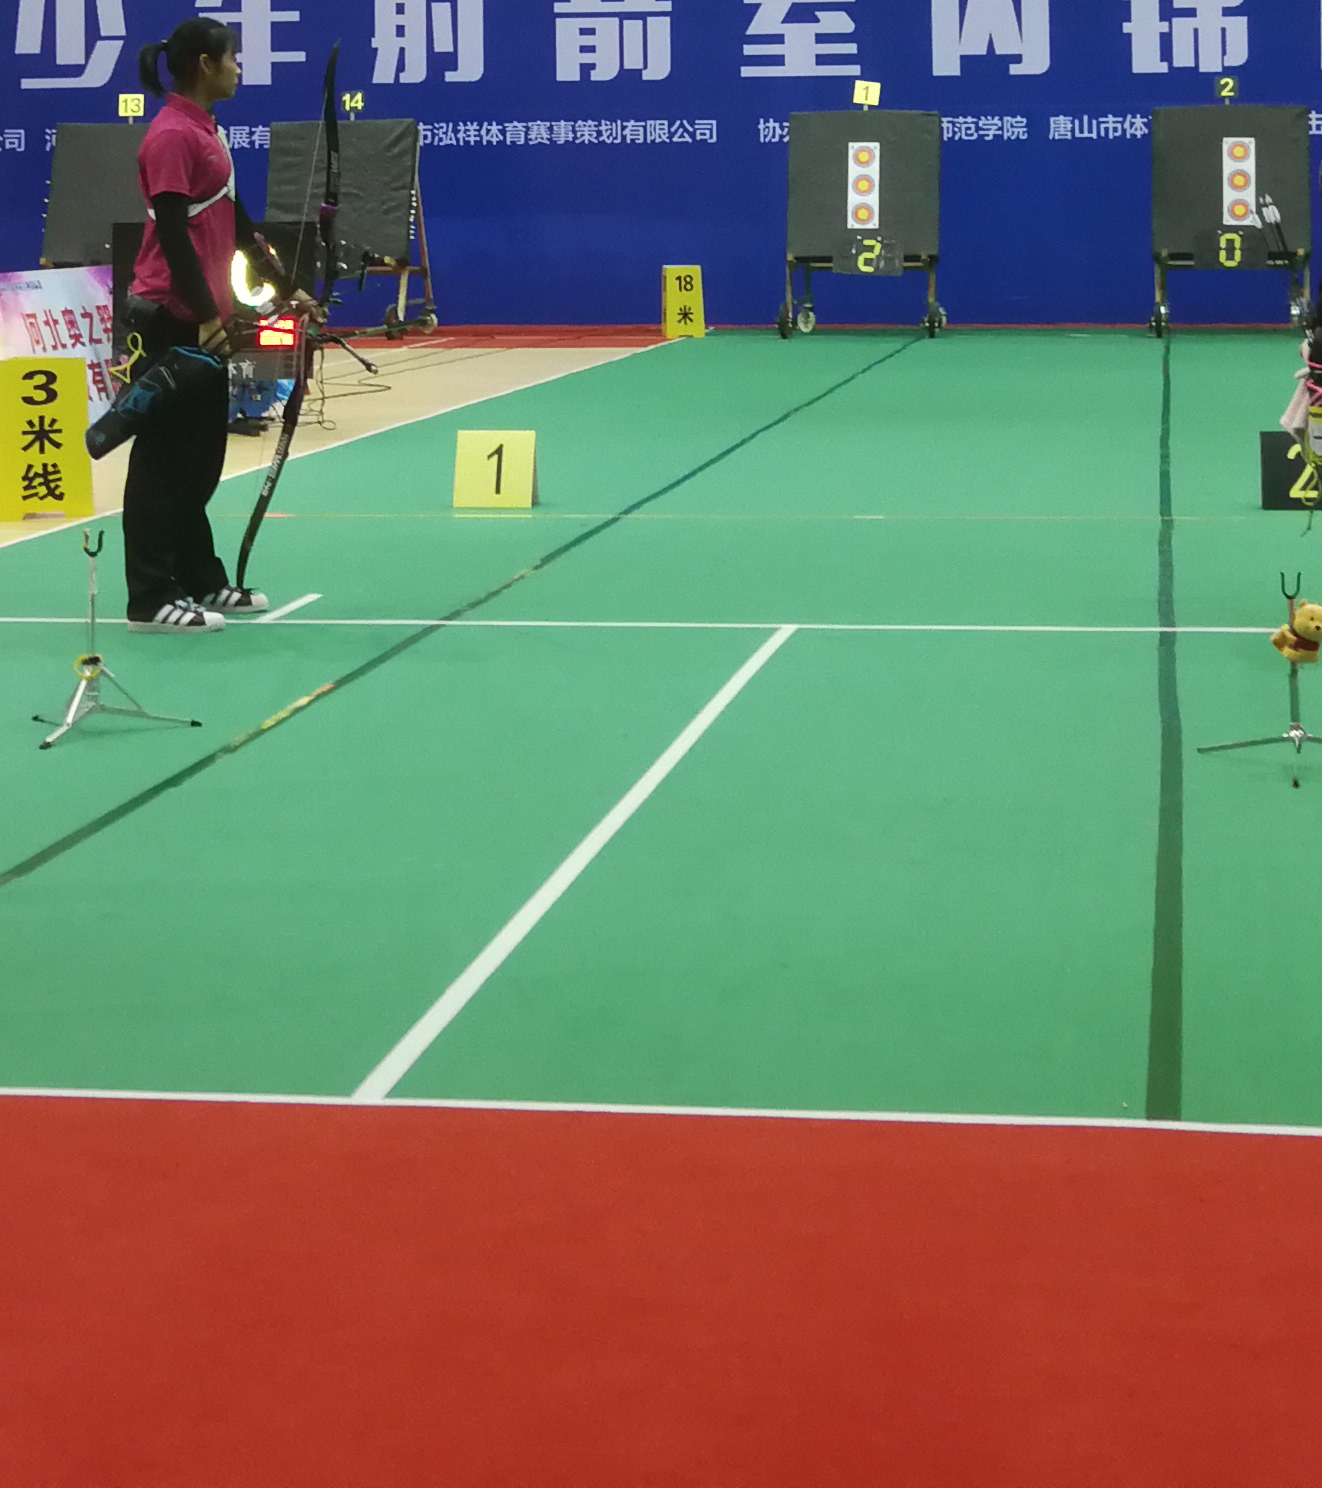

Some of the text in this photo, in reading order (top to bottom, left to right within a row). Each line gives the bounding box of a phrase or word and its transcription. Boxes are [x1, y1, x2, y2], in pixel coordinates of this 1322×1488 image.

[342, 92, 365, 111] 14
[861, 85, 871, 102] 1
[1219, 78, 1235, 97] 2
[121, 97, 143, 113] 13
[1048, 114, 1152, 141] 唐山市体
[857, 239, 883, 273] 2
[1218, 232, 1242, 268] 0
[20, 368, 66, 503] 3米线
[485, 442, 504, 497] 1
[1286, 443, 1319, 499] 2
